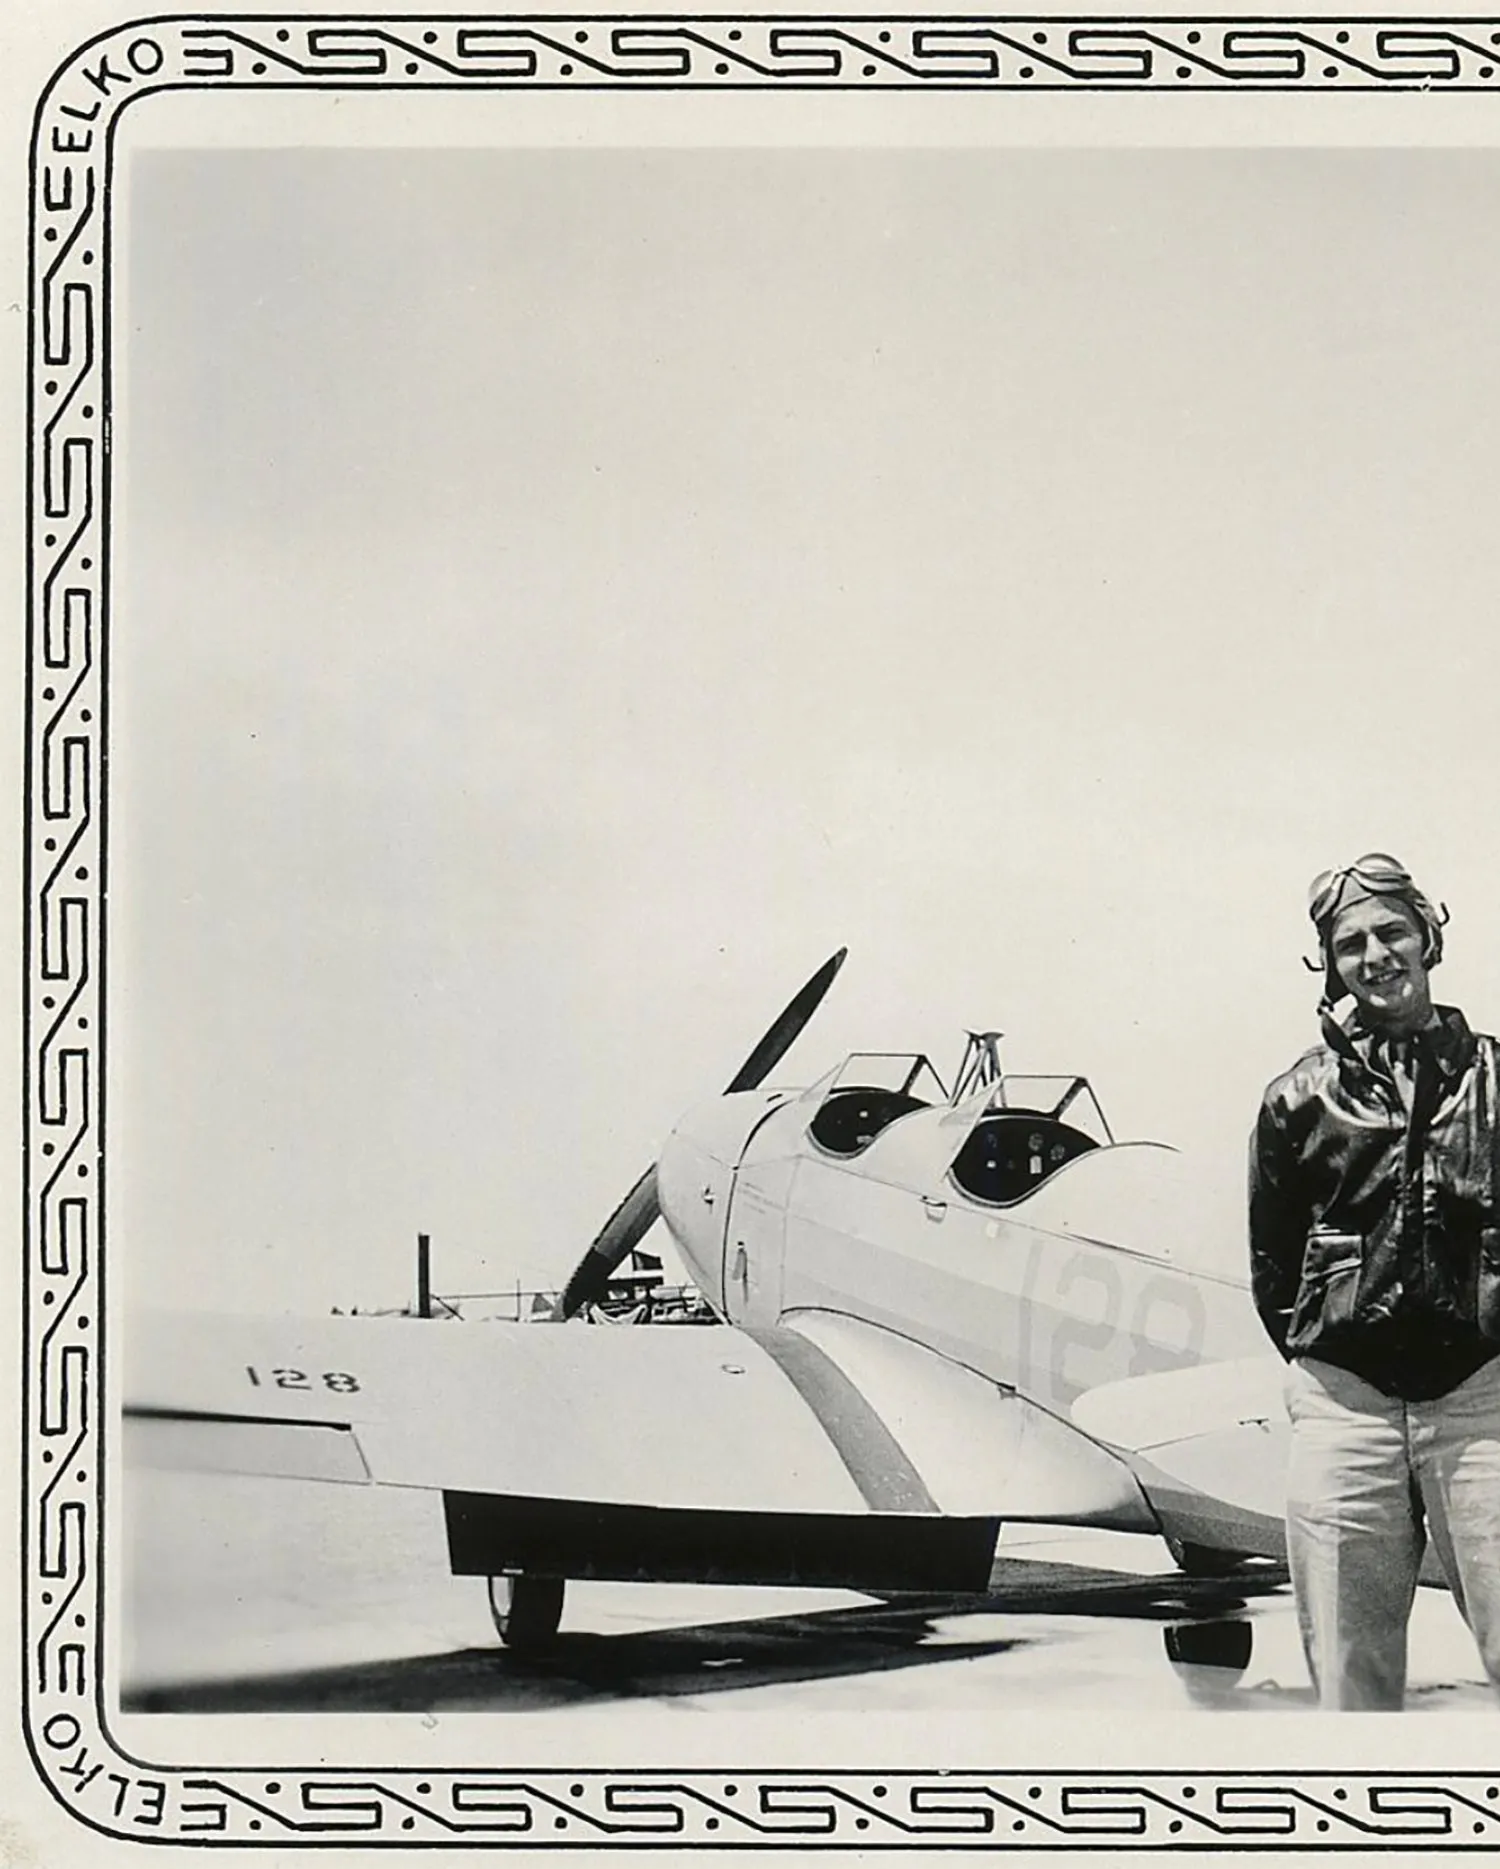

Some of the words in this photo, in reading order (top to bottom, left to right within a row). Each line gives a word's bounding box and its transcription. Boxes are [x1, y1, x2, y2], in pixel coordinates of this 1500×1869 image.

[51, 37, 165, 154] ELKO
[246, 1365, 361, 1393] 128
[42, 1713, 168, 1826] ELKO
